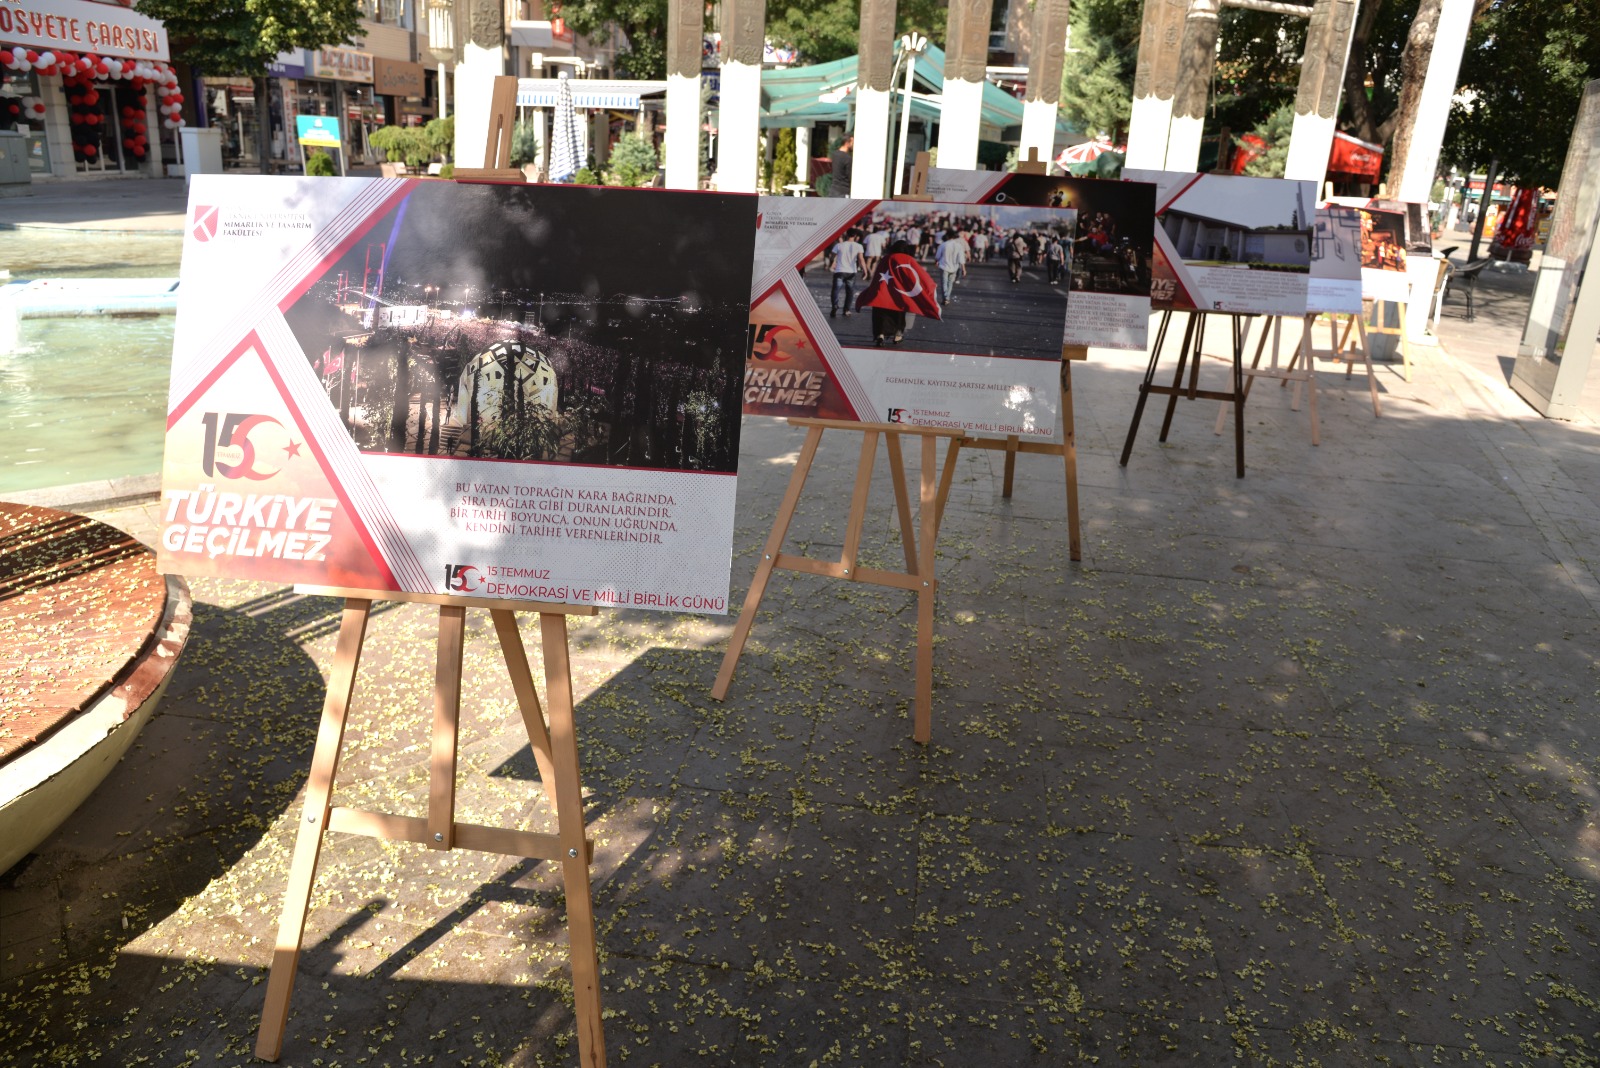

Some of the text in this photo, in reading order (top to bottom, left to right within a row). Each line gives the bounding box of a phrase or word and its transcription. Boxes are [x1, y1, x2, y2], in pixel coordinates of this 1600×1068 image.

[87, 21, 159, 55] ÇARŞISI
[744, 363, 827, 390] RKİYE
[958, 381, 986, 390] ŞARTSIZ
[743, 386, 822, 407] ÇİLMEZ
[921, 409, 951, 418] TEMMUZ
[912, 418, 961, 429] DEMOKRASİ
[962, 422, 974, 430] VE
[975, 422, 997, 431] MİLLİ
[998, 424, 1025, 434] BİRLİK
[456, 482, 471, 493] BU
[474, 483, 510, 495] VATAN
[514, 485, 574, 499] TOPRAĞIN
[578, 489, 608, 501] KARA
[165, 483, 338, 532] TÜRKİYE
[461, 495, 487, 507] SIRA
[489, 496, 536, 510] DAĞLAR
[539, 498, 563, 512] GİBİ
[450, 506, 468, 518] BİR
[472, 508, 507, 521] TARİH
[573, 515, 611, 527] ONUN
[162, 524, 332, 562] GEÇİLMEZ
[465, 521, 663, 544] KENDİNİ TARİHE VERENLERİNDİR.
[487, 565, 551, 580] 15 TEMMUZ
[486, 582, 725, 611] DEMOKRASİ VE MİLLİ BİRLİK GÜNÜ
